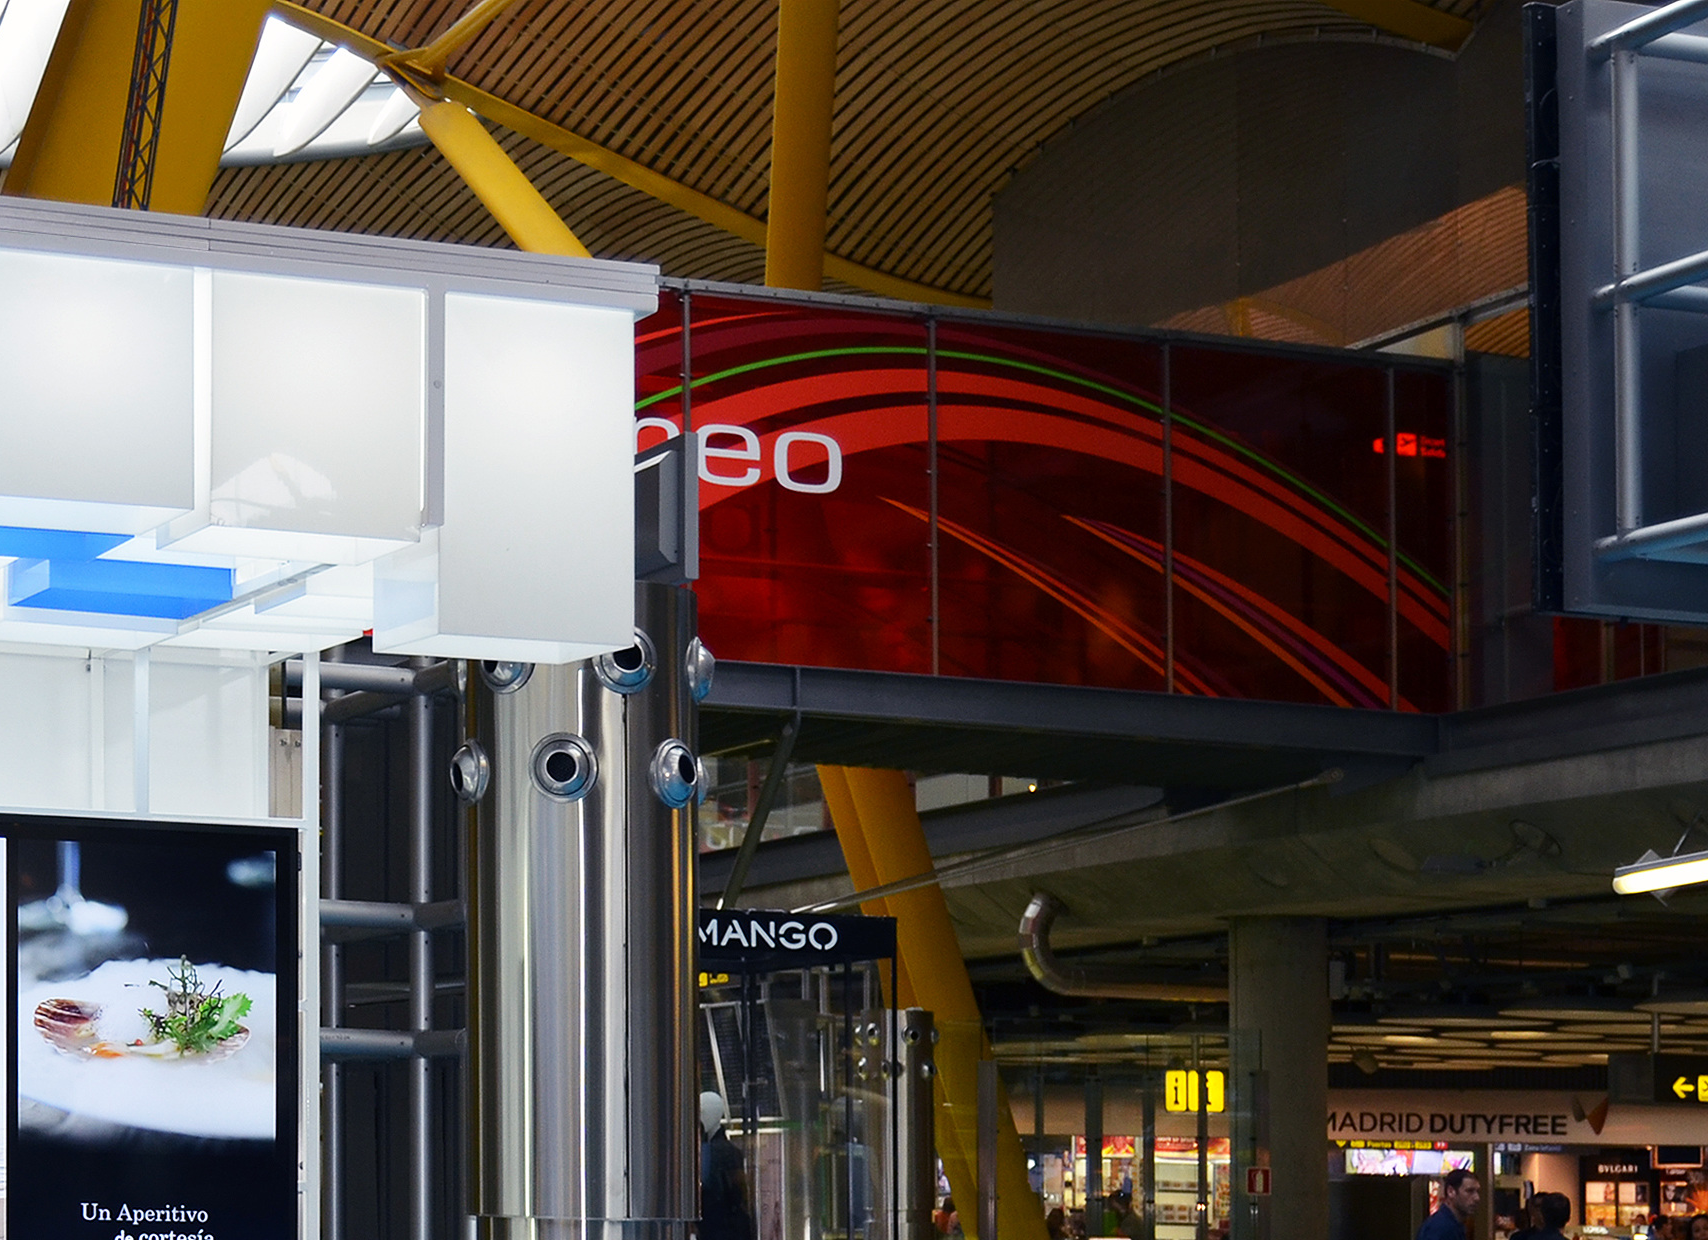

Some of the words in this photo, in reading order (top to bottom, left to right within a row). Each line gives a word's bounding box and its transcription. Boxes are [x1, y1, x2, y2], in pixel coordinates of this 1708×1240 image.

[699, 919, 838, 950] MANGO
[80, 1202, 111, 1221] Un
[116, 1203, 209, 1225] Aperitivo
